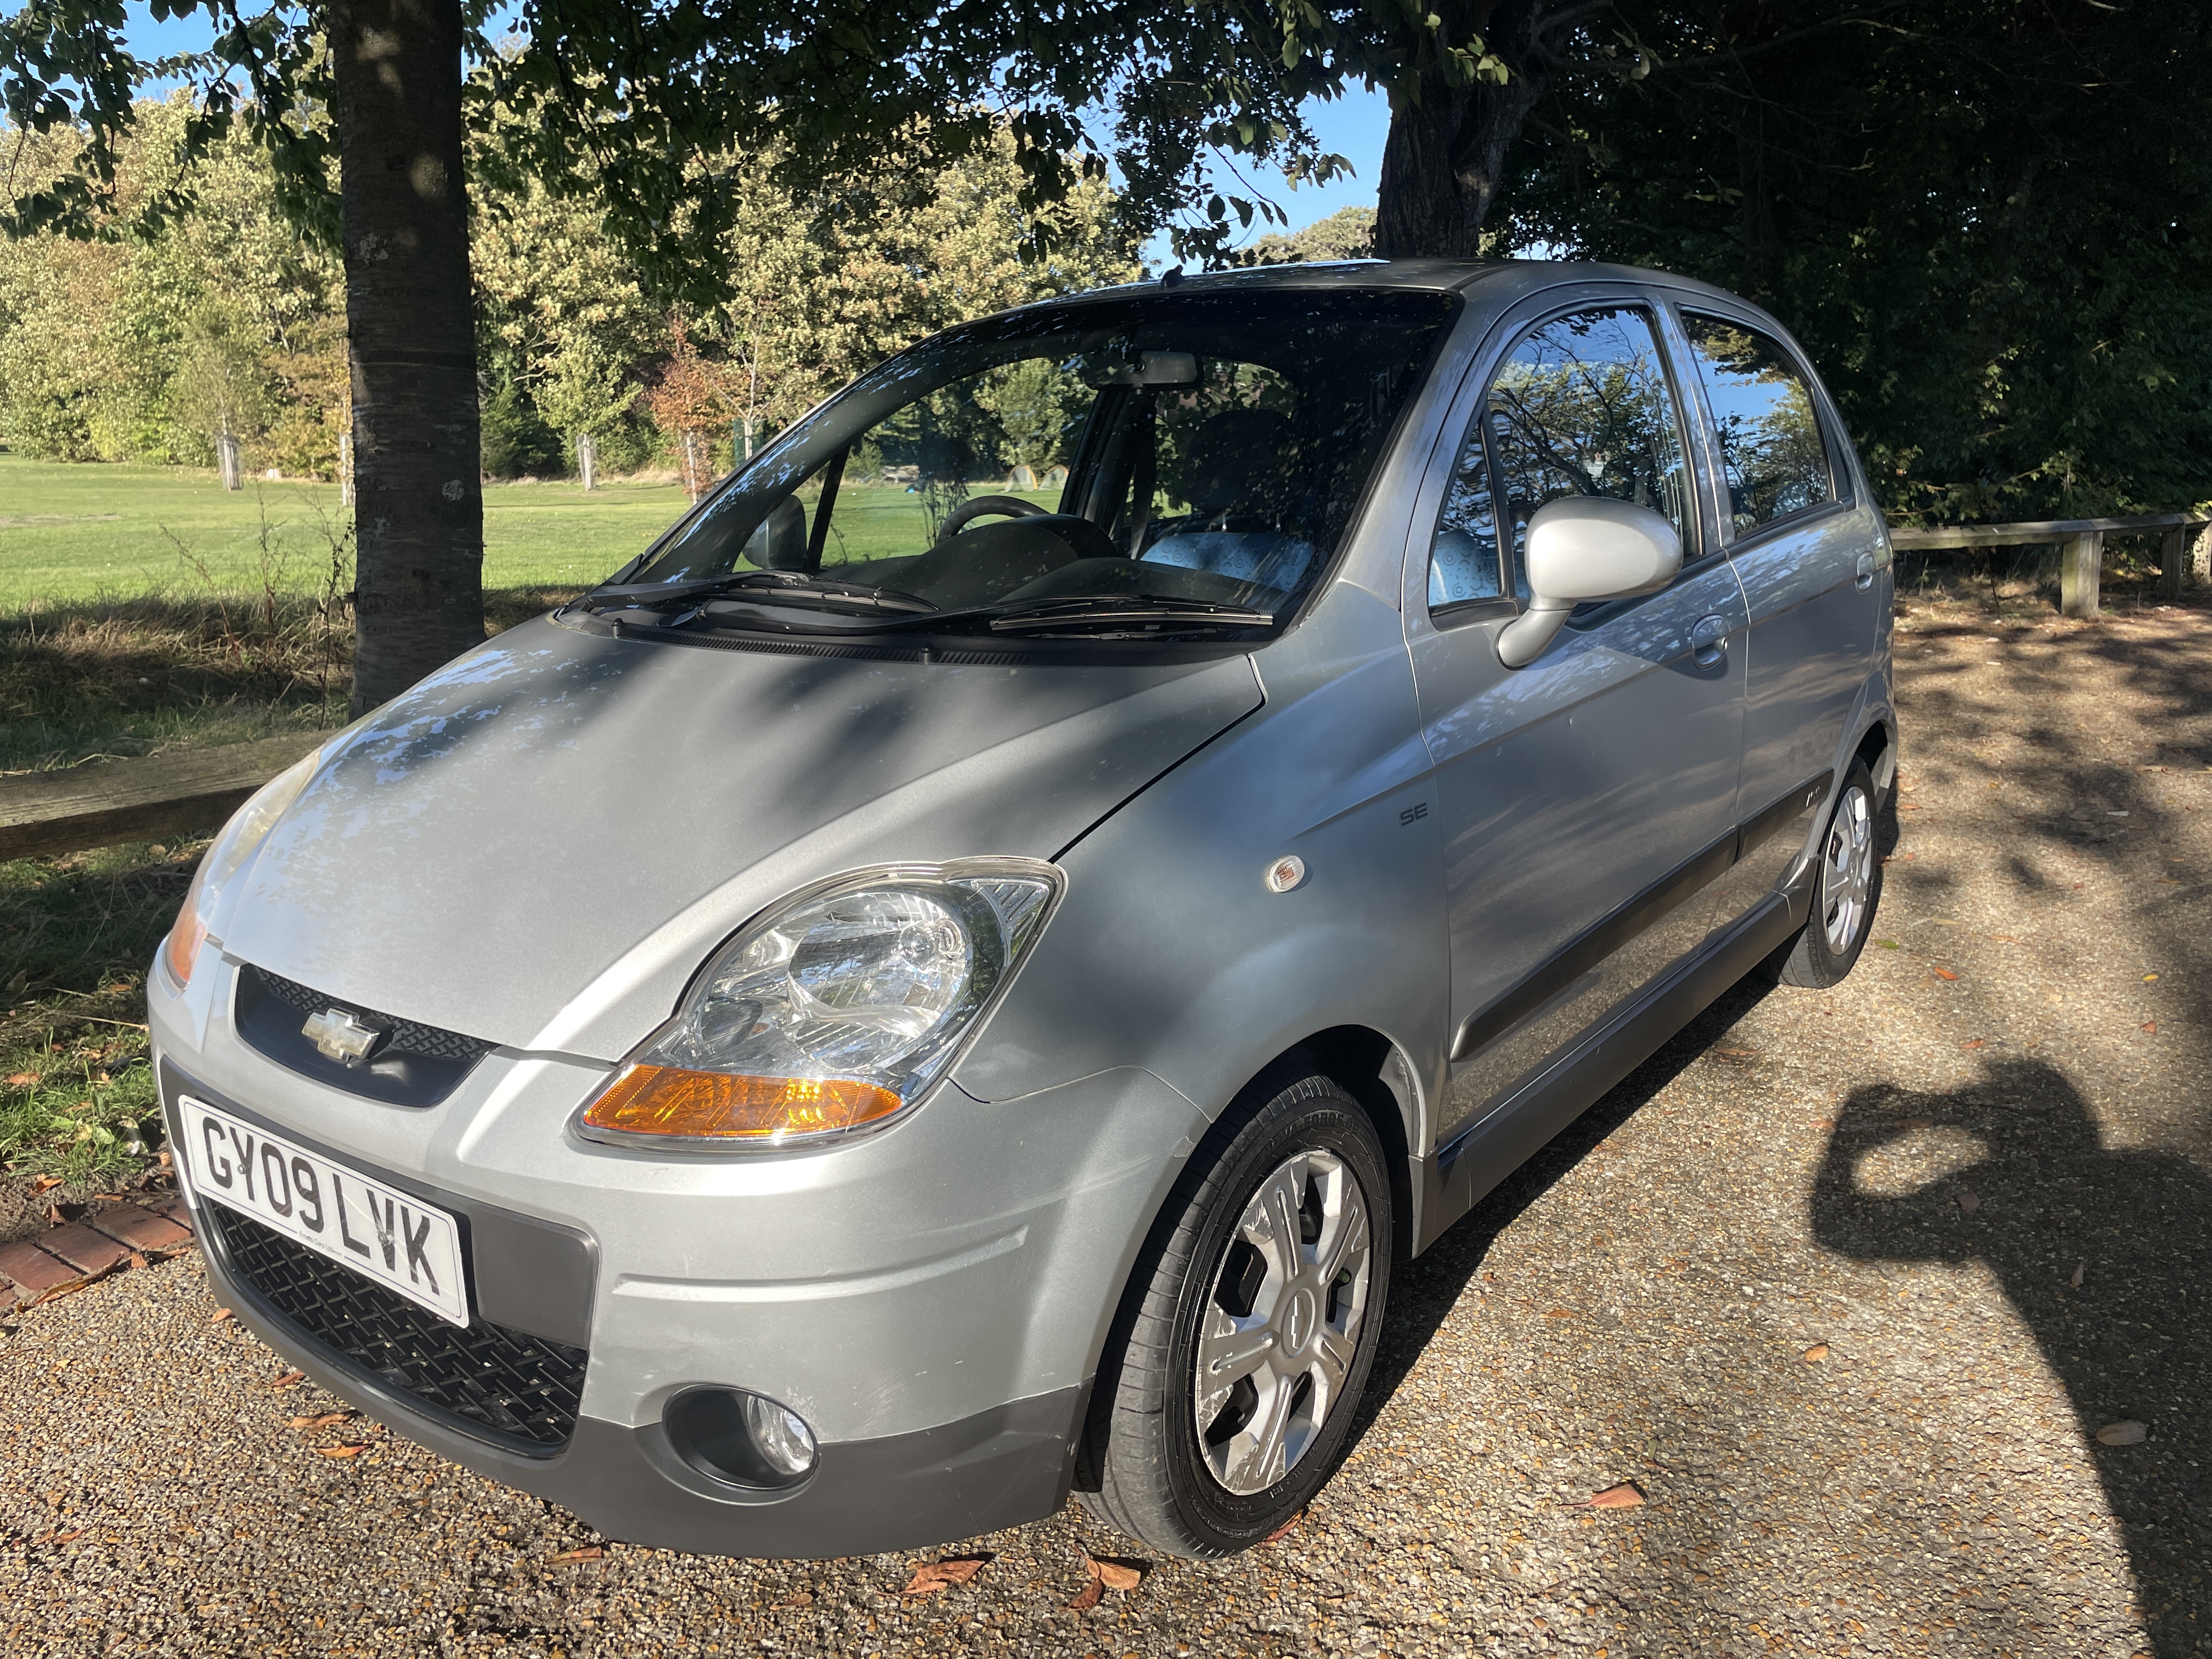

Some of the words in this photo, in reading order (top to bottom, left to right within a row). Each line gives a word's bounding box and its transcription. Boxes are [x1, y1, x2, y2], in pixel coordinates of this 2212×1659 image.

[1400, 803, 1428, 826] SE
[203, 1116, 324, 1233] GY09
[332, 1172, 440, 1296] LVK
